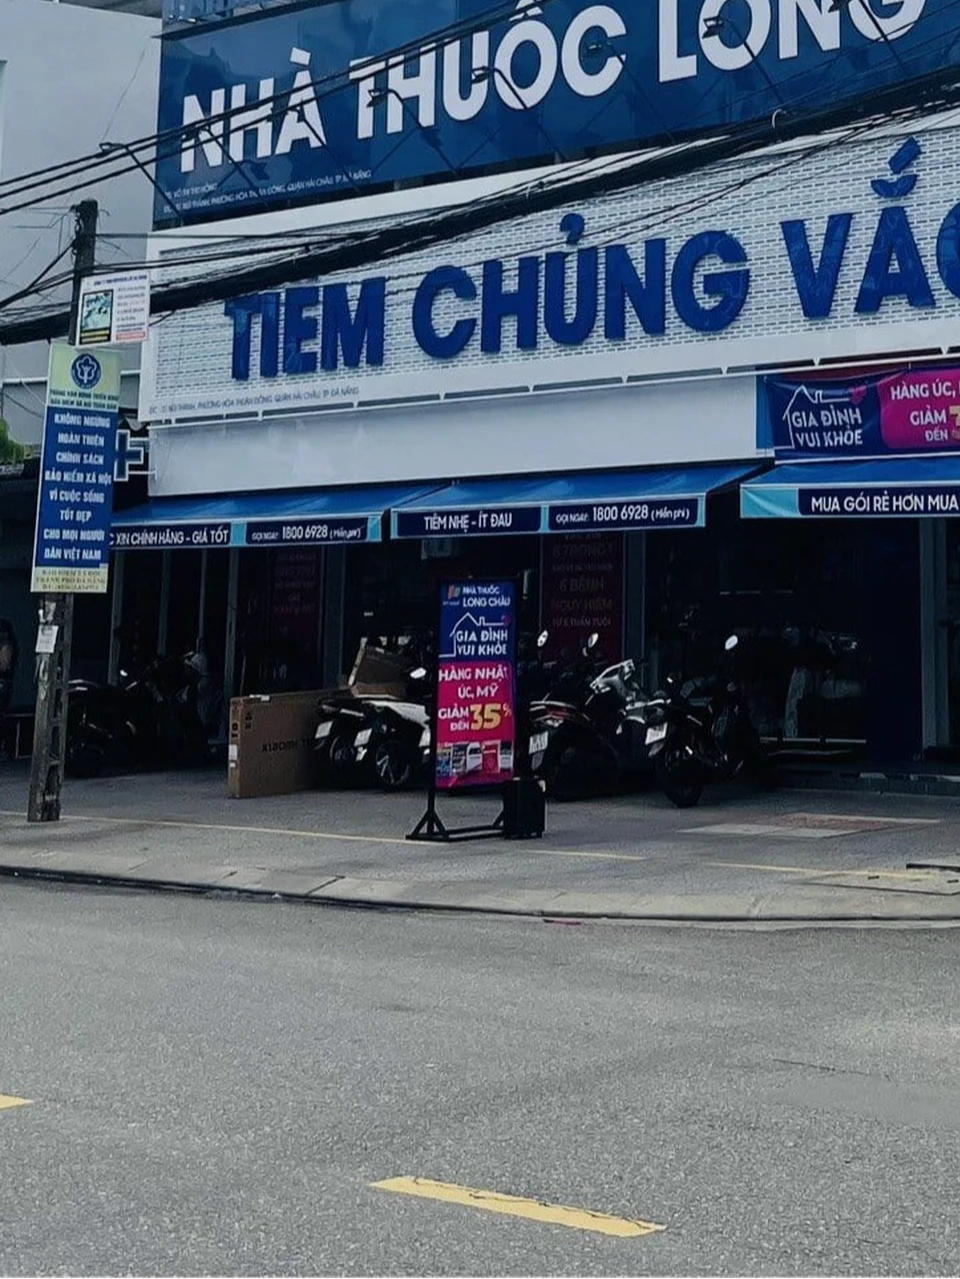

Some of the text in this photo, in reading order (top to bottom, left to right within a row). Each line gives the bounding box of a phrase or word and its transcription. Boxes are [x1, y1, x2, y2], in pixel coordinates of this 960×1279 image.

[180, 46, 327, 173] NHÀ
[412, 213, 750, 360] CHỦNG
[890, 381, 929, 400] HÀNG
[932, 379, 956, 398] ÚC,
[791, 404, 862, 428] GIA ĐÌNH
[910, 405, 947, 425] GIẢM
[796, 424, 863, 448] VUI KHỎE
[925, 428, 948, 442] ĐẾN
[811, 496, 841, 512] MUA
[844, 491, 870, 512] GÓI
[874, 490, 890, 512] RẺ
[893, 493, 925, 511] HƠN
[927, 495, 959, 511] MUA
[592, 506, 618, 522] 1800
[620, 504, 648, 520] 6928
[423, 512, 512, 533] TIÊM NHẸ ÍT ĐAU
[43, 528, 60, 539] CHO
[131, 530, 158, 545] CHÍNH
[192, 528, 208, 544] GIÁ
[210, 525, 230, 543] TỐT
[282, 526, 303, 539] 1800
[305, 525, 328, 539] 6928
[63, 546, 81, 562] VIỆT
[82, 549, 102, 560] NAM
[463, 597, 487, 607] LONG
[488, 595, 511, 607] CHÂU
[456, 627, 508, 643] GIA ĐÌNH
[457, 640, 508, 656] VUI KHỎE
[438, 665, 472, 682] HÀNG
[457, 683, 499, 700] ÚC, MỸ
[437, 703, 470, 719] GIẢM
[449, 720, 470, 732] ĐẾN
